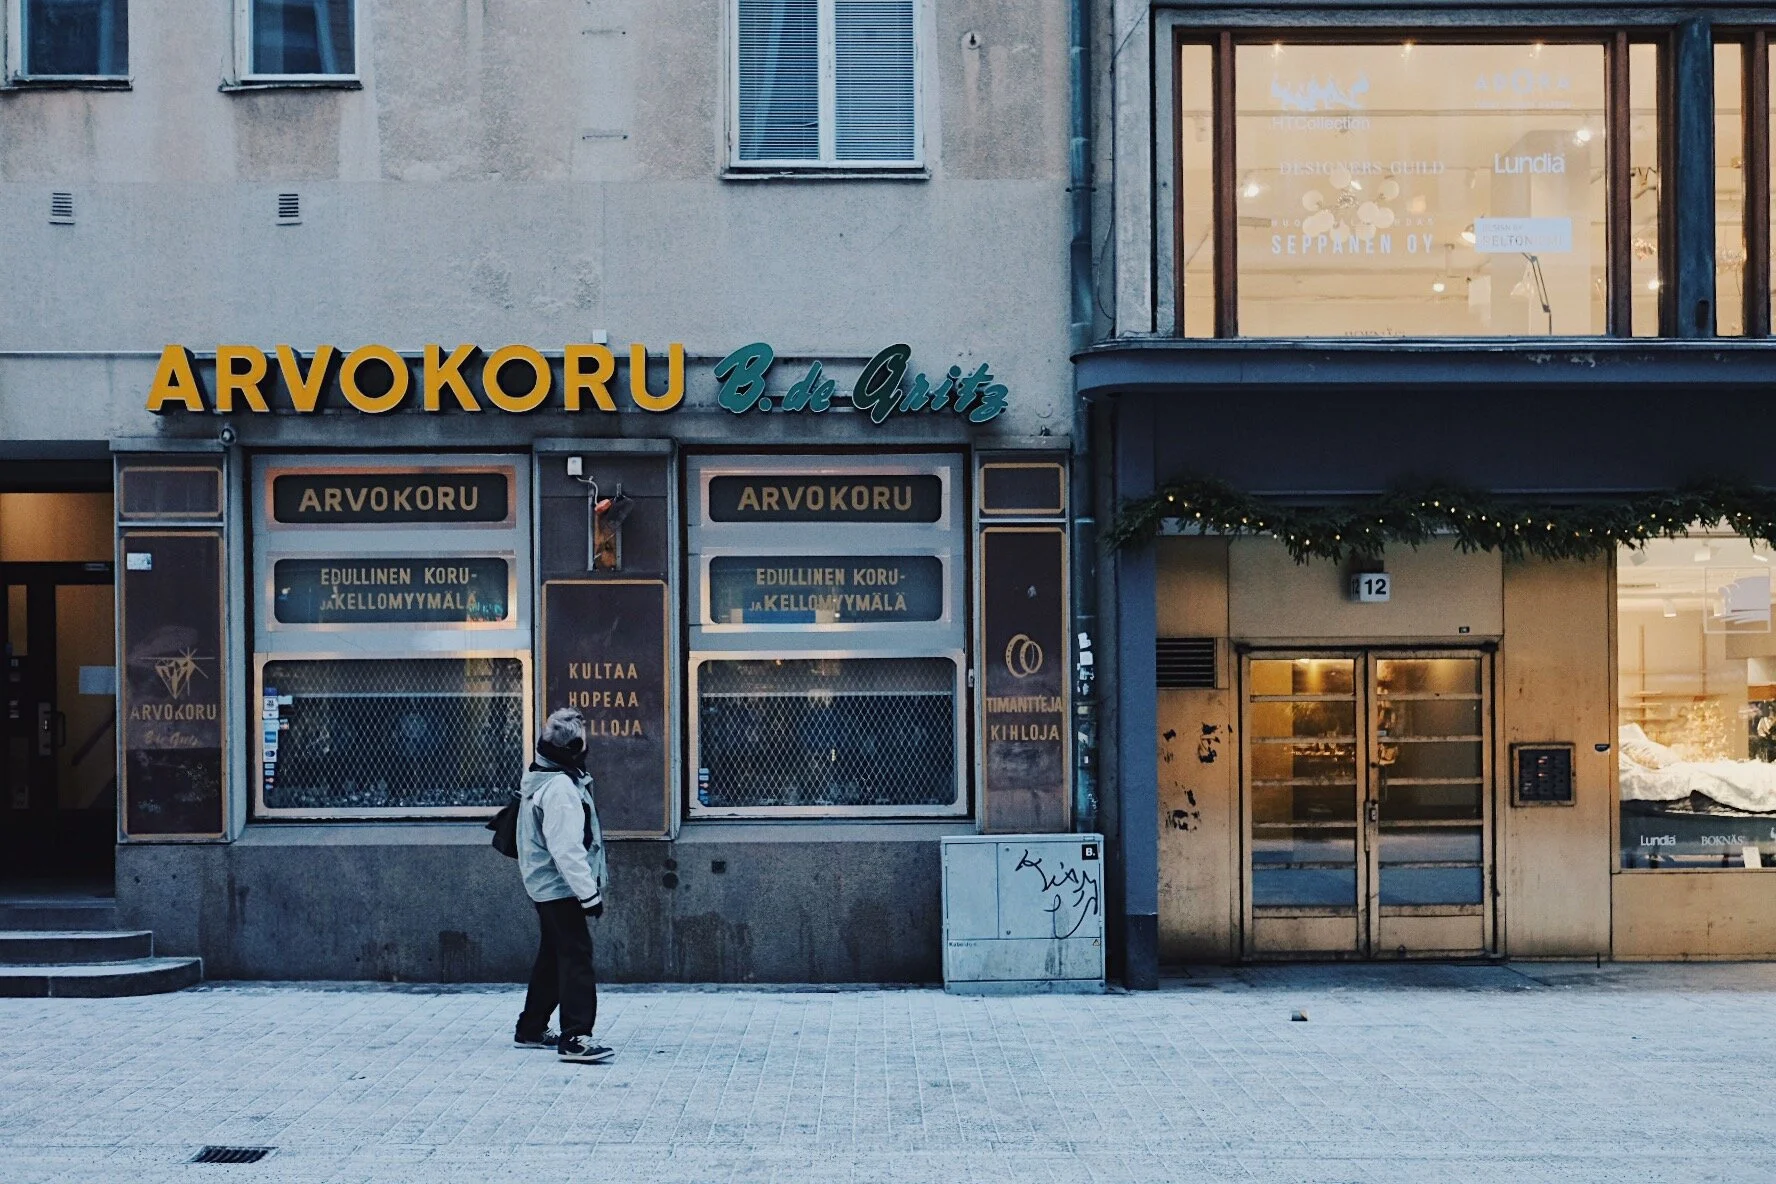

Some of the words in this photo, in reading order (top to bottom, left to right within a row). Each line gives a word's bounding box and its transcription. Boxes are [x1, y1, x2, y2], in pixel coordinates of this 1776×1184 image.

[1280, 161, 1382, 175] DESIGNERS
[1391, 161, 1444, 175] GUILD
[1495, 153, 1565, 174] Lundia
[1407, 233, 1434, 254] OY
[146, 343, 686, 415] ARVOKORU
[299, 486, 479, 512] ARVOKORU
[737, 486, 912, 511] ARVOKORU
[320, 568, 411, 585] EDULLINEN
[424, 567, 477, 585] KORU-
[756, 568, 845, 586] EDULLINEN
[853, 568, 906, 586] KORU-
[1364, 578, 1387, 595] 12
[569, 663, 638, 680] KULTAA
[568, 692, 639, 708] HOPEAA
[987, 696, 1062, 713] TIMANTTEJA
[130, 704, 217, 721] ARVOKORU
[584, 719, 643, 736] LLOJA
[990, 724, 1060, 741] KIHLOJA
[1640, 835, 1676, 846] Lundia
[1701, 835, 1743, 846] BOKNÄS
[1085, 847, 1096, 857] B.
